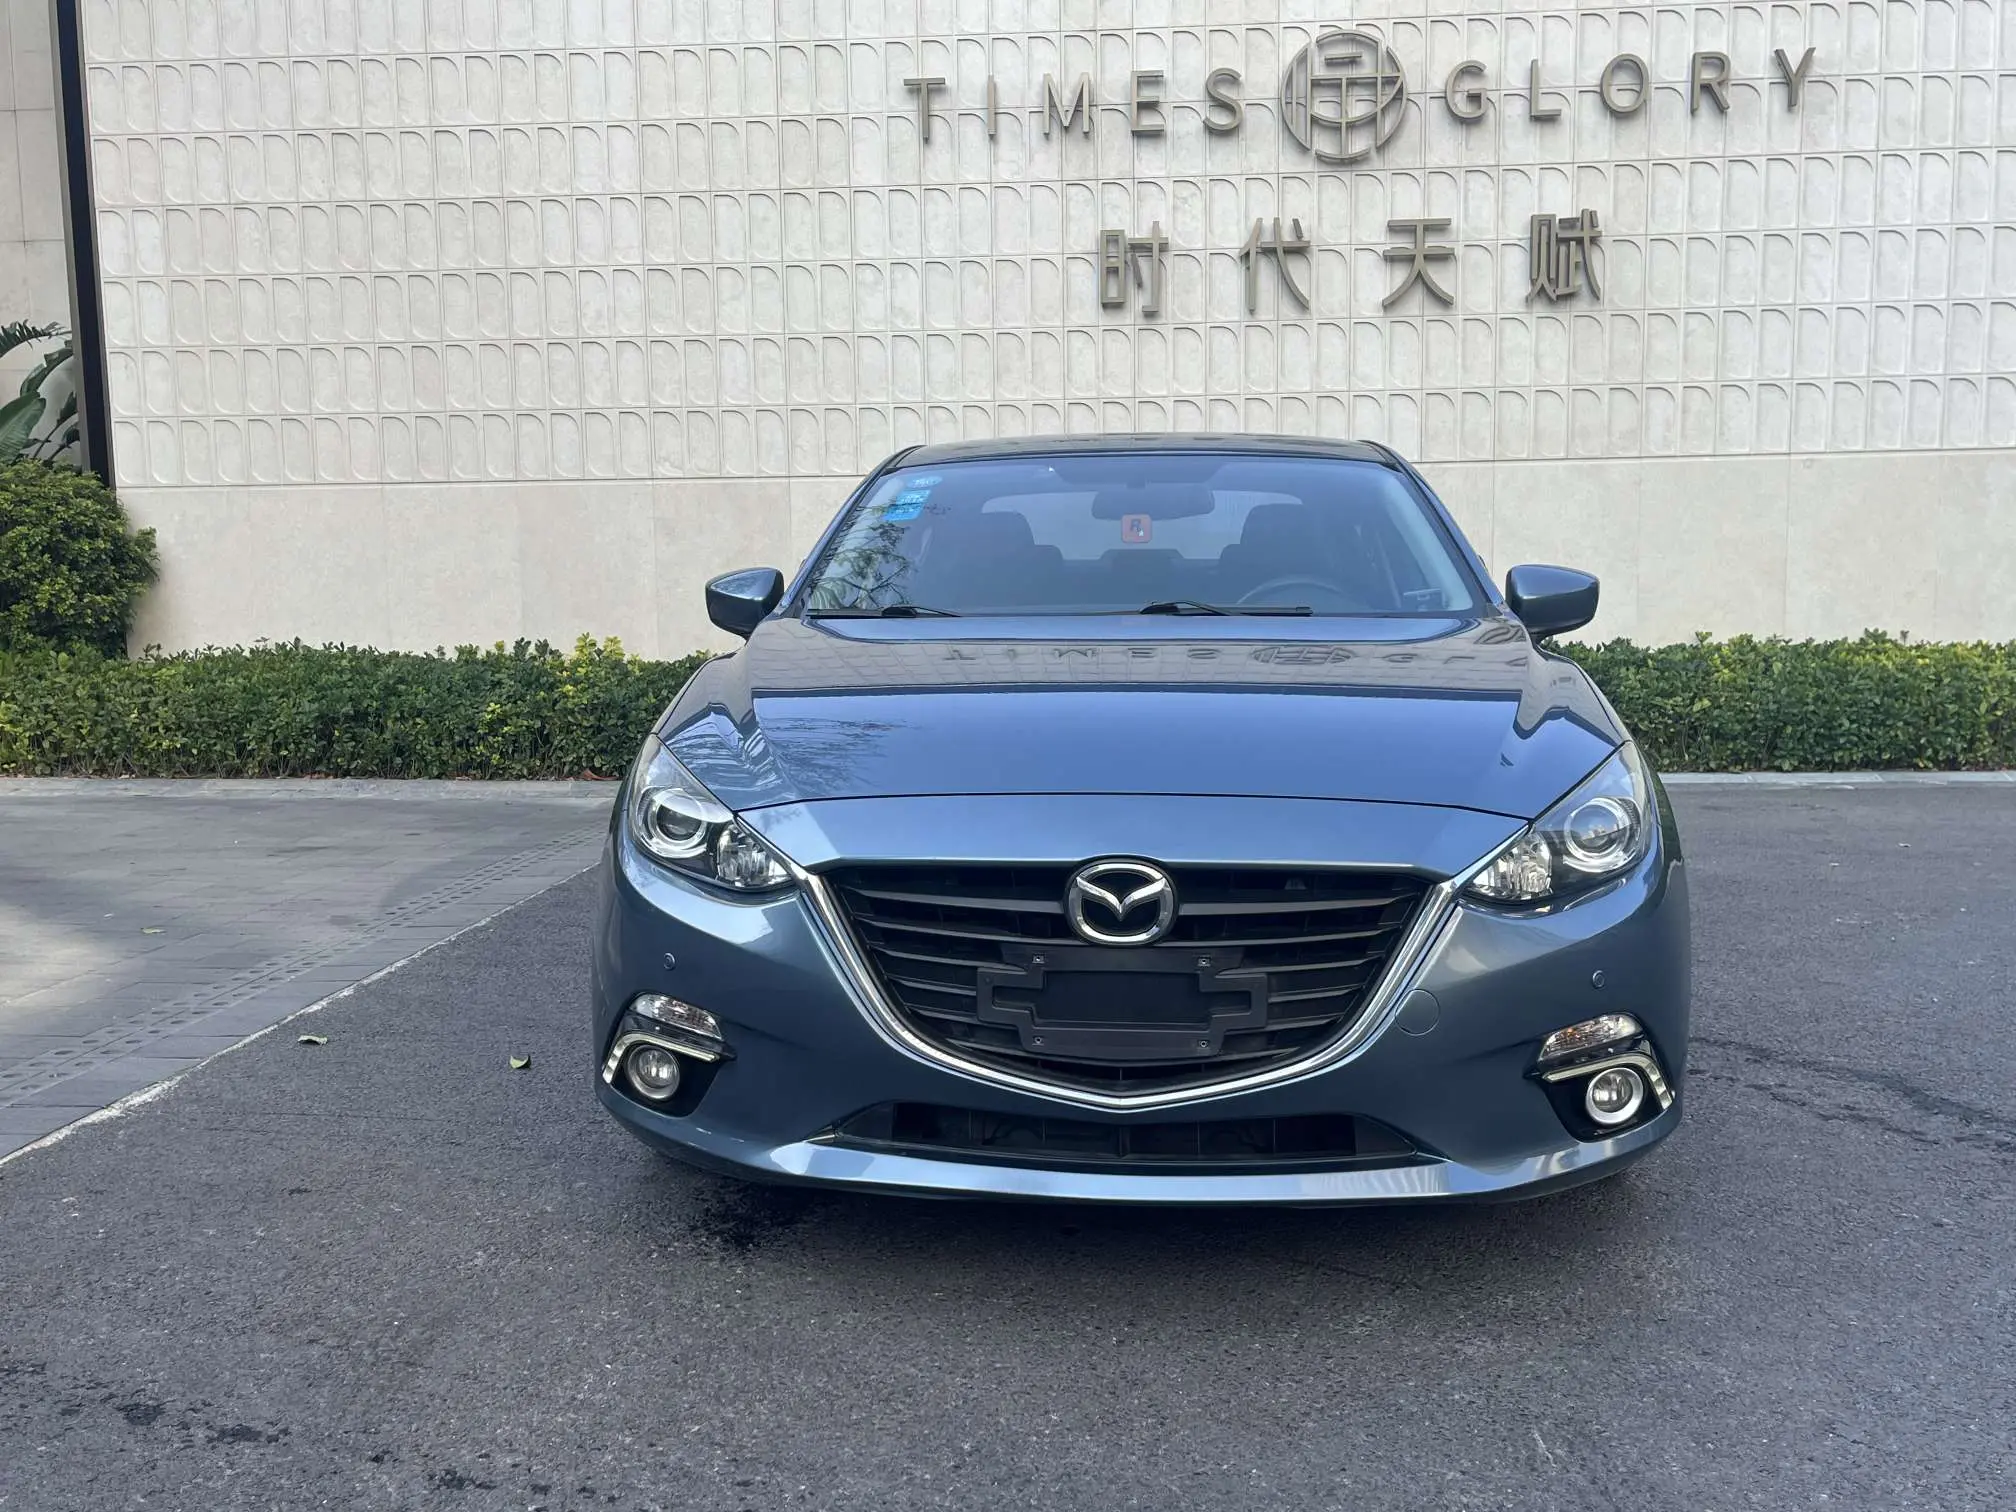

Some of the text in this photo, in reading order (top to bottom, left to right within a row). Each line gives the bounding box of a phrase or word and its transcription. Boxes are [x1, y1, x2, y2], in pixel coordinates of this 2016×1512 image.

[903, 47, 1816, 143] TIMES GLORY
[1100, 208, 1602, 314] 时代天赋
